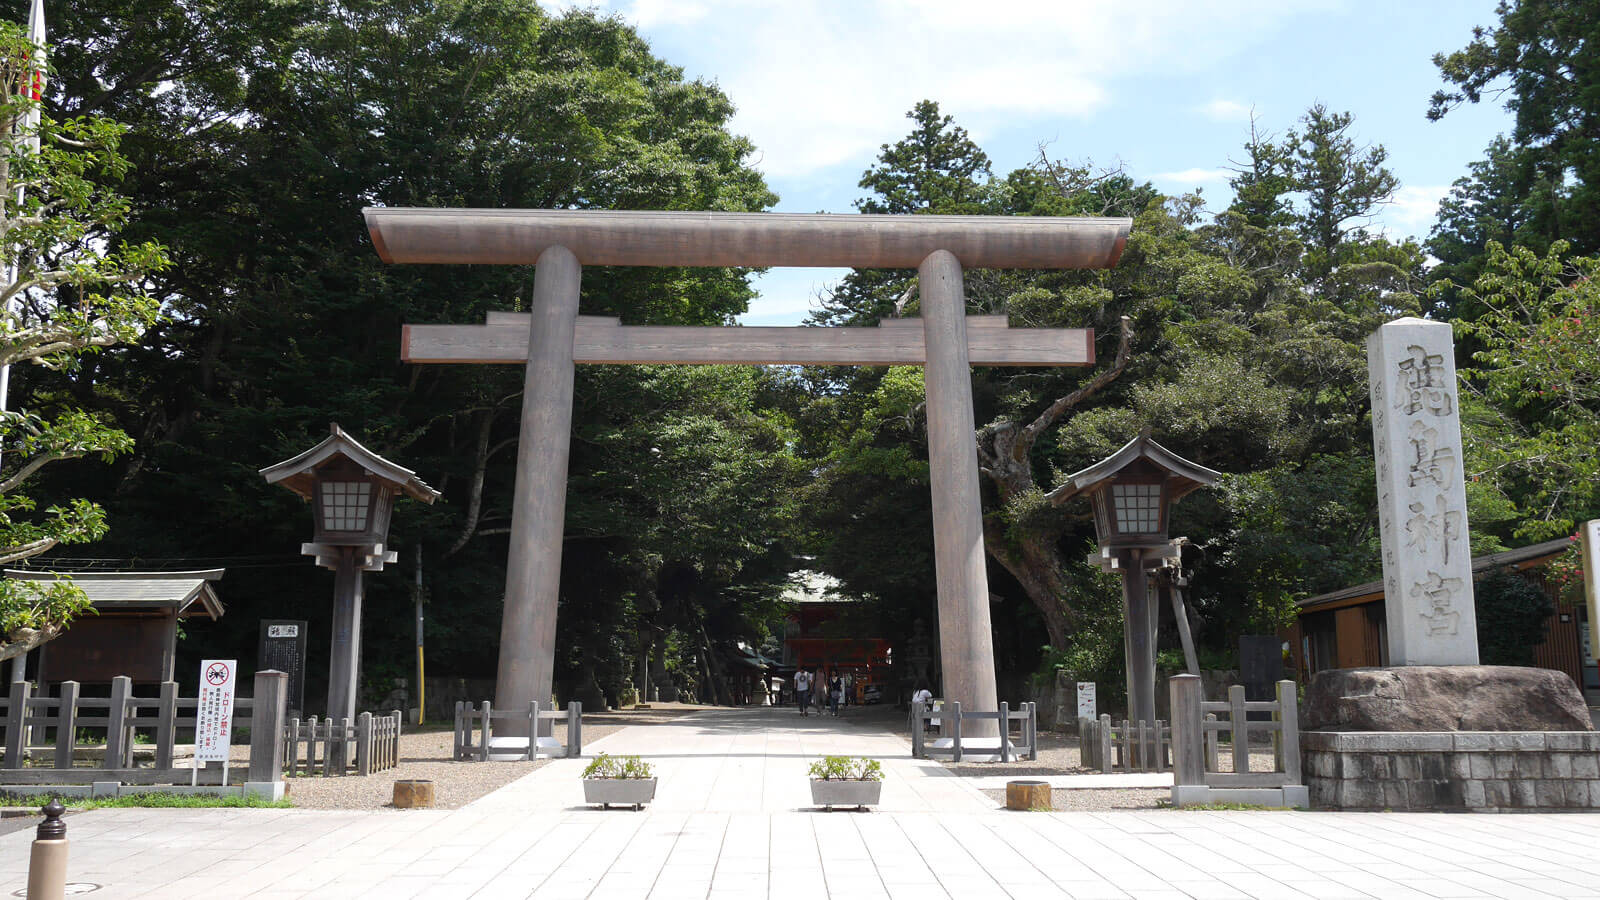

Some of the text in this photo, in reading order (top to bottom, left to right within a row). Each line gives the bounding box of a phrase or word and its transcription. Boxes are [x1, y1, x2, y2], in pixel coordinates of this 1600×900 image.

[1394, 344, 1464, 637] 鹿島神宮
[220, 691, 230, 736] ドローン禁止
